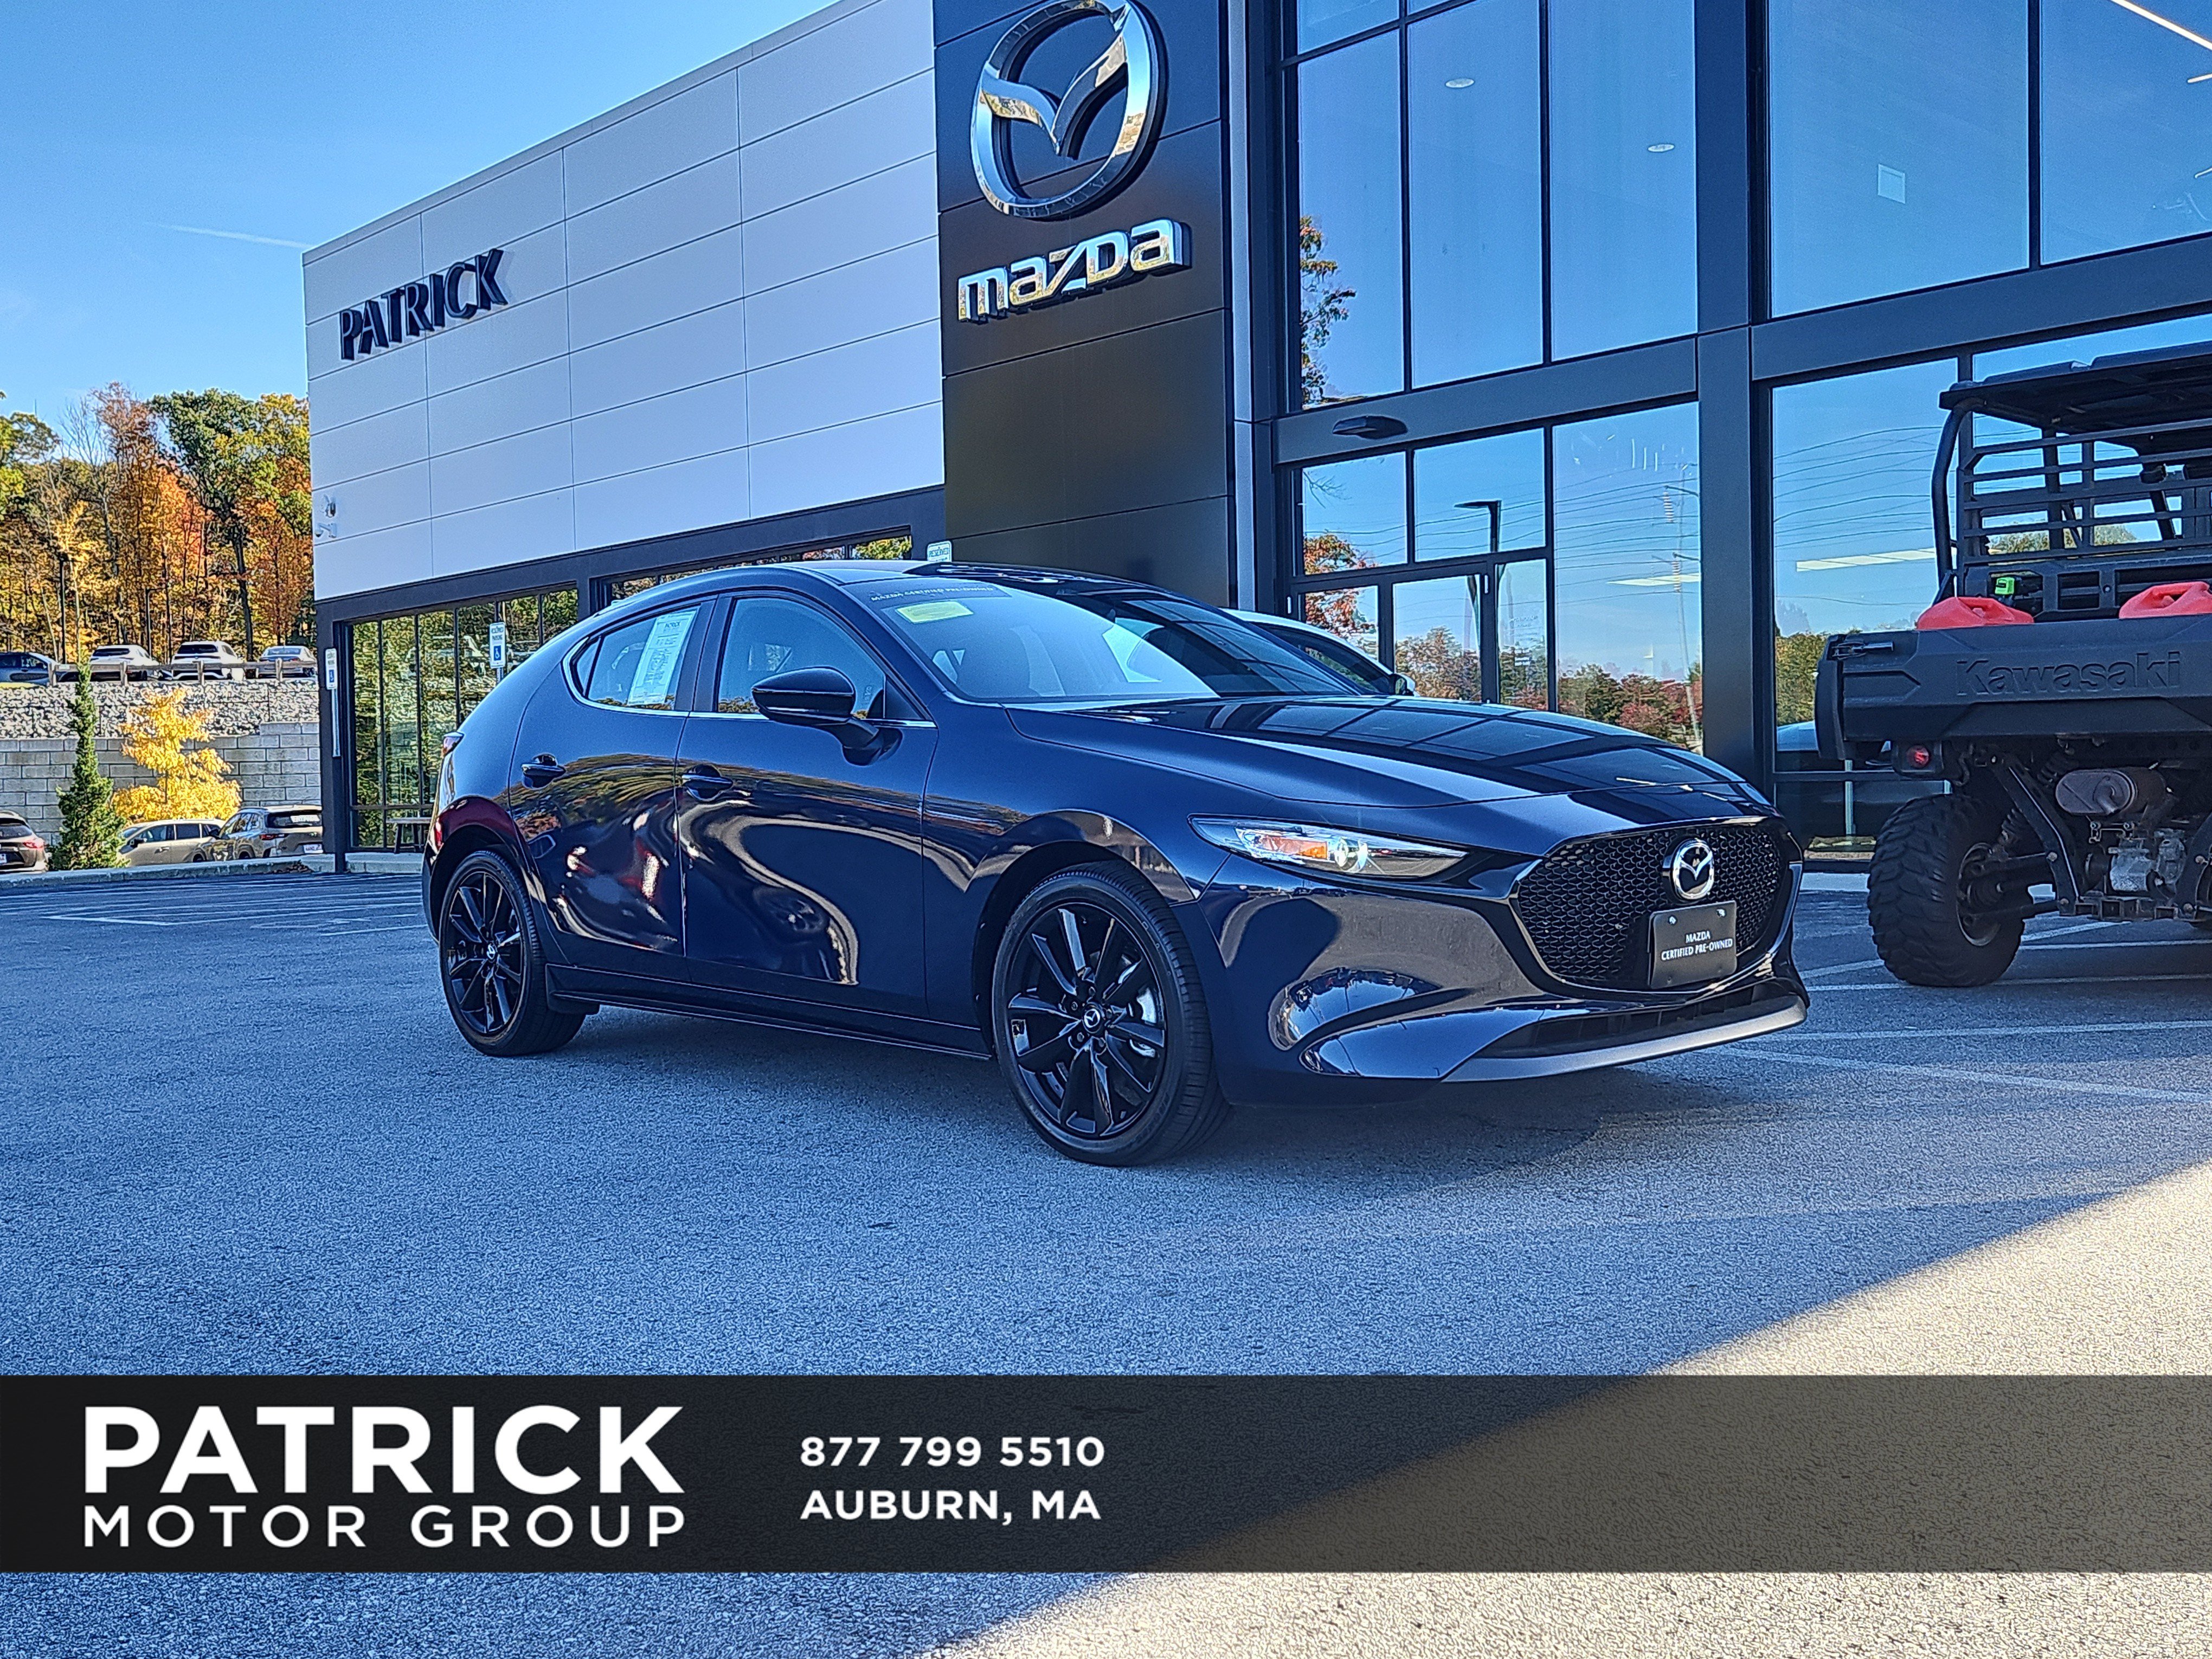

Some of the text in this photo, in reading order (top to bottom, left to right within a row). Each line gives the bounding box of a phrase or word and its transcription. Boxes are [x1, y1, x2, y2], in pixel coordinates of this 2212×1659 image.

[957, 217, 1185, 321] mazda
[340, 248, 509, 360] PATRICK
[1957, 652, 2181, 696] Kawasaki
[1661, 938, 1733, 961] CERTIFIED PRE-OWNED
[1686, 931, 1711, 943] MAZDA
